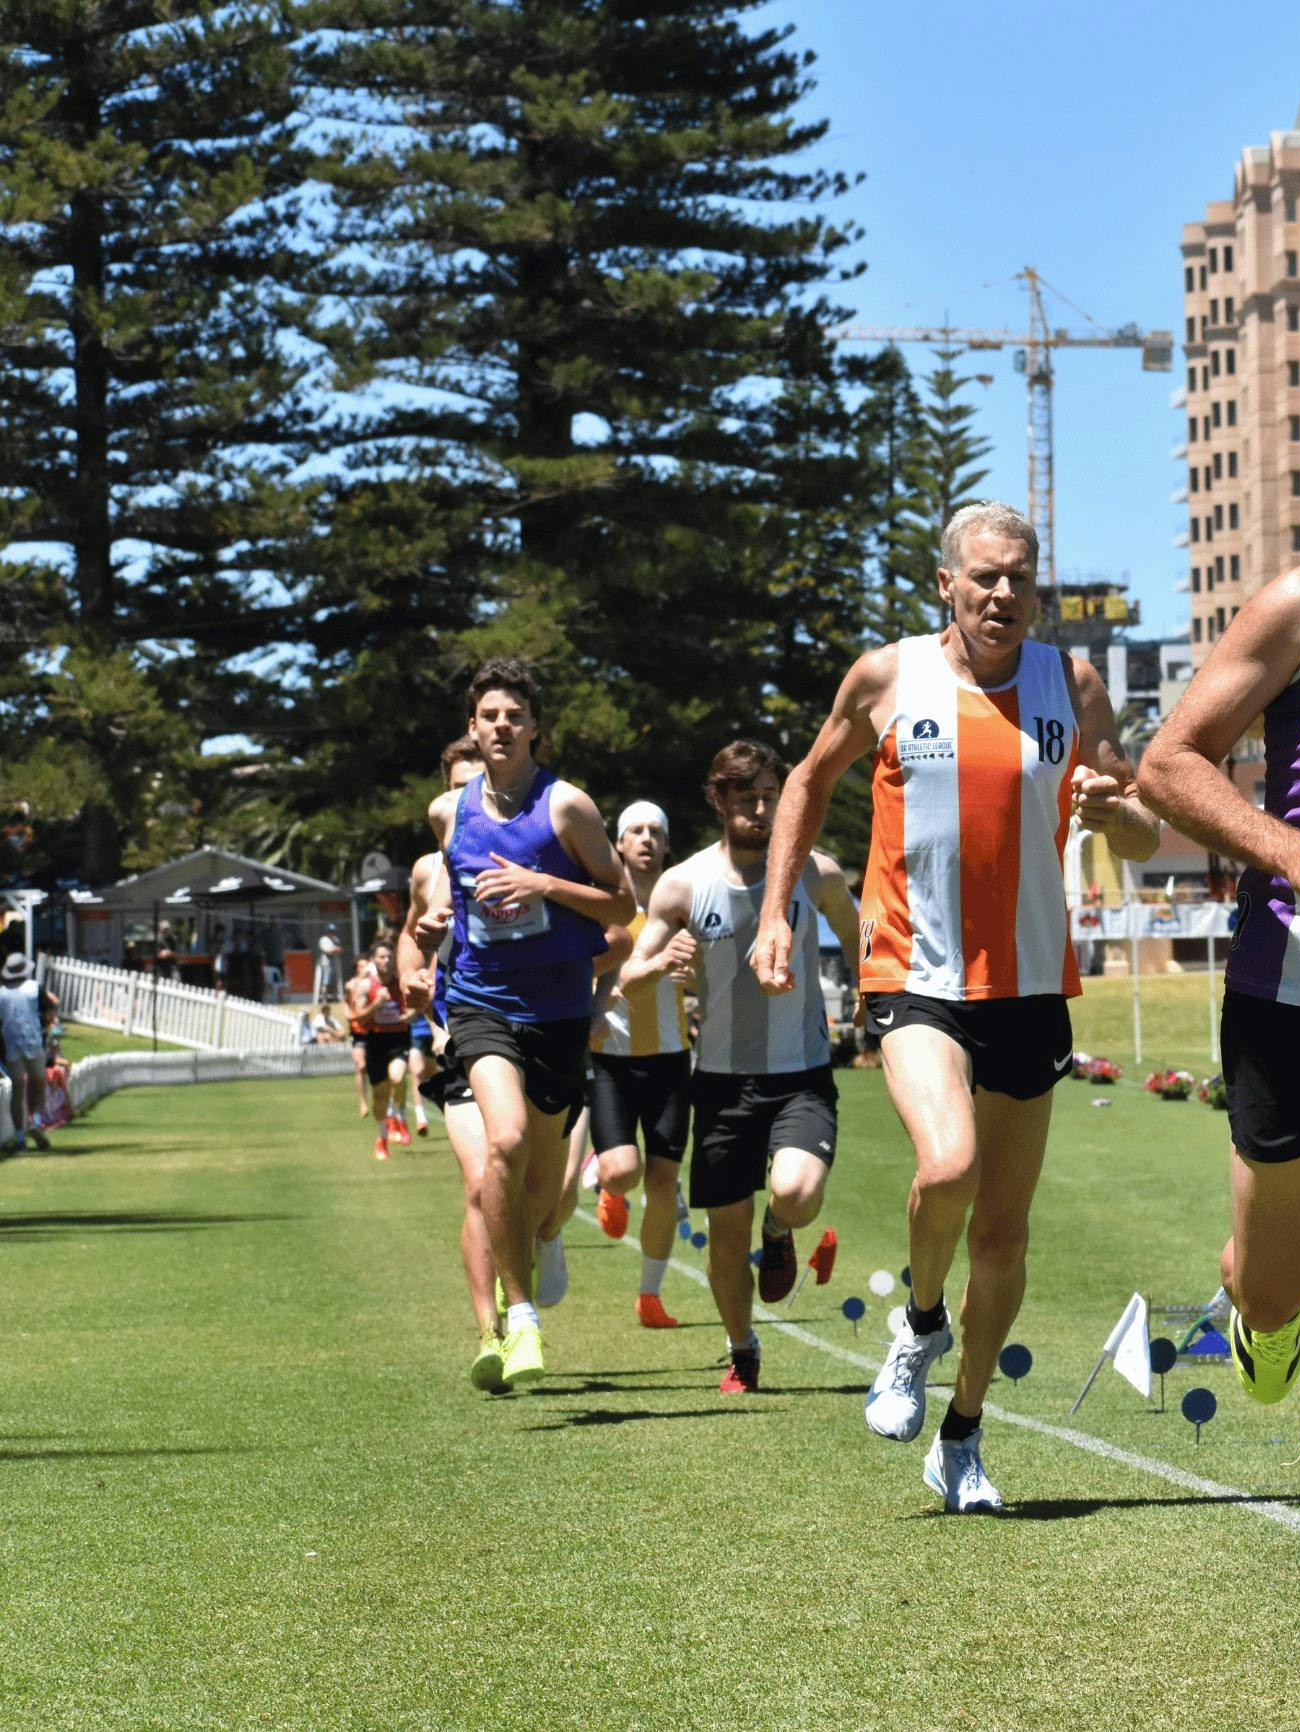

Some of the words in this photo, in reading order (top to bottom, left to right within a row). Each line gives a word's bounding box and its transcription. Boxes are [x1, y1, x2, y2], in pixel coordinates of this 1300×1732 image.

[908, 742, 931, 751] ATHLETIC
[932, 741, 953, 750] LEAGUE
[1033, 716, 1065, 765] 18
